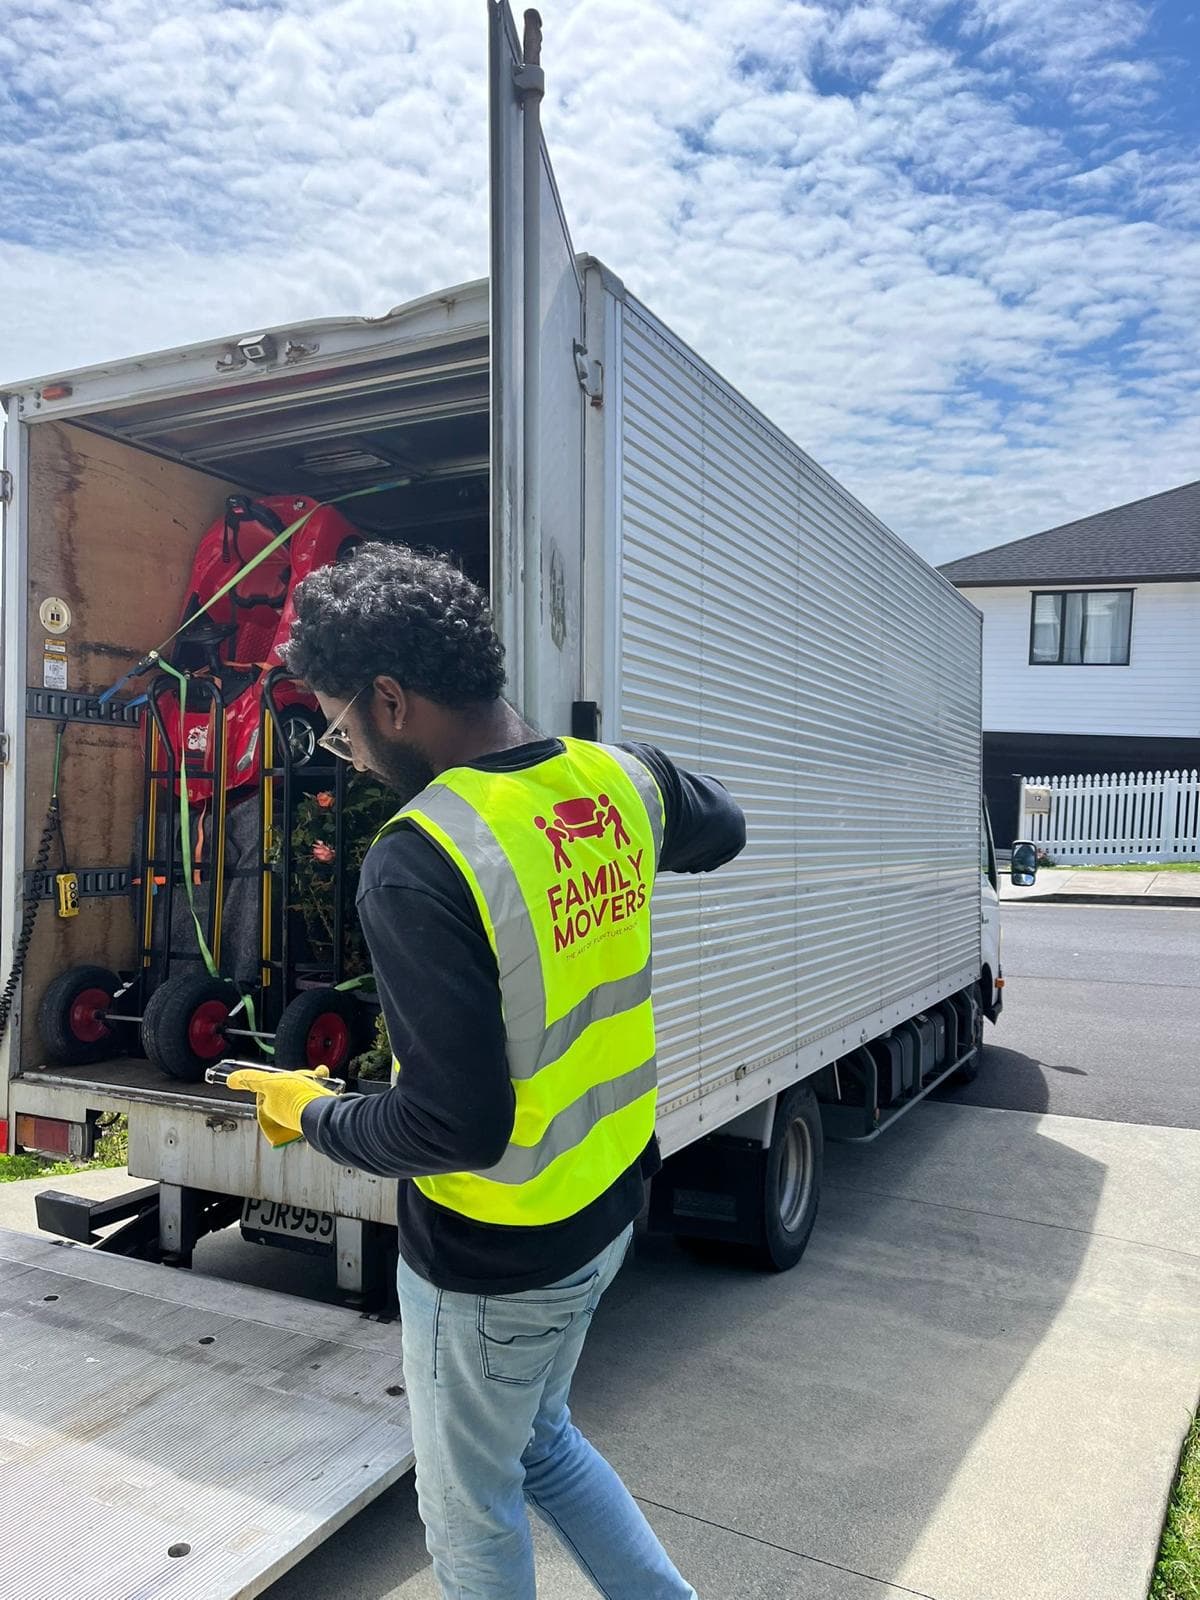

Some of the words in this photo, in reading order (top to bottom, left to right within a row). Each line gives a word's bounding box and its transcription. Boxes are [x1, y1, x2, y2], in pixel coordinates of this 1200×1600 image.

[547, 849, 643, 921] FAMILY
[554, 883, 646, 953] MOVERS
[244, 1198, 333, 1236] PJR955
